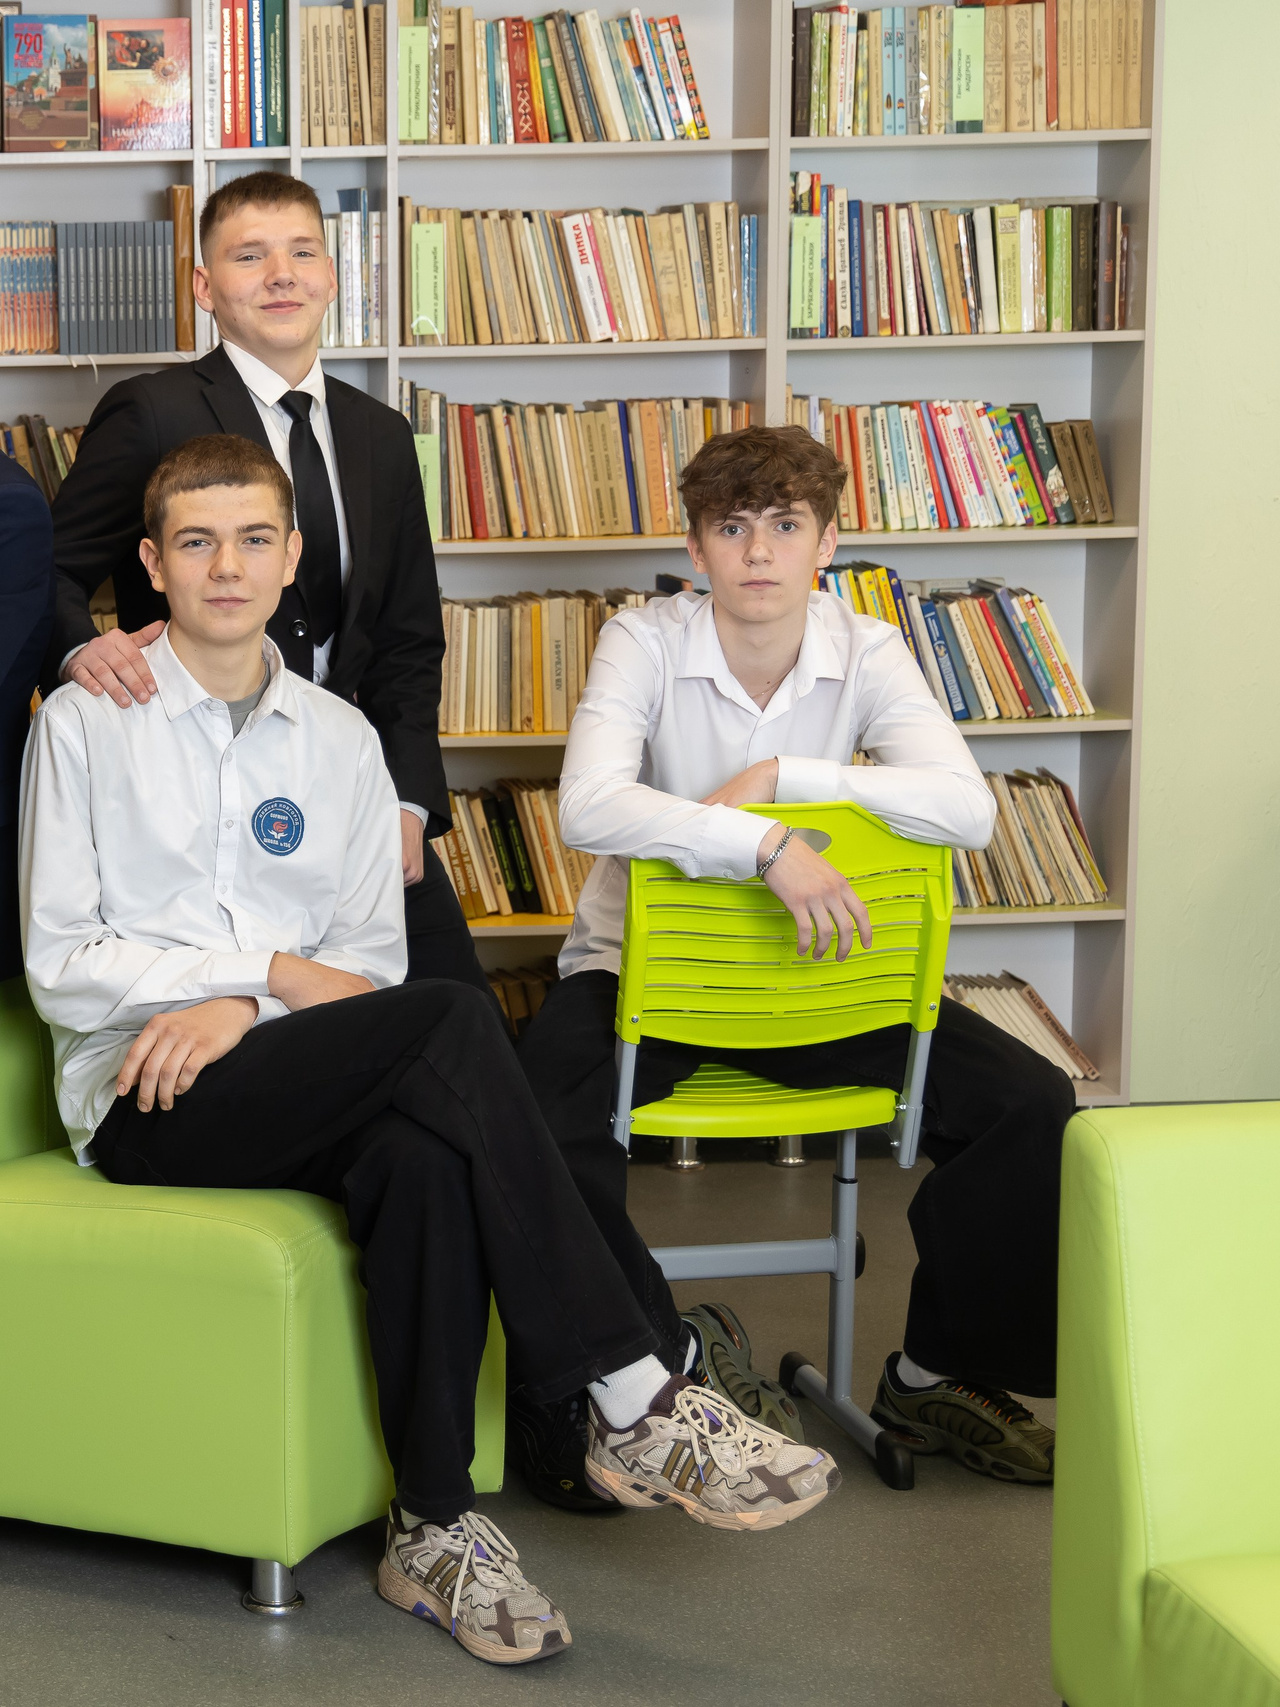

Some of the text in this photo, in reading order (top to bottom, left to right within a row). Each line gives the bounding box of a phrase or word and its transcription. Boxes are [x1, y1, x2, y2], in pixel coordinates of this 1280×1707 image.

[14, 33, 42, 53] 790
[572, 223, 590, 265] ДИНКА
[714, 221, 725, 273] РАССКАЗЫ
[807, 242, 815, 270] СКАЗКИ
[431, 246, 439, 274] дружбе
[1104, 260, 1113, 282] ПАКС
[554, 639, 562, 677] КУЗЬМИН
[258, 802, 300, 826] НИЖНИЙ НОВГОРОД
[1026, 989, 1044, 1010] ДЕТЯМ
